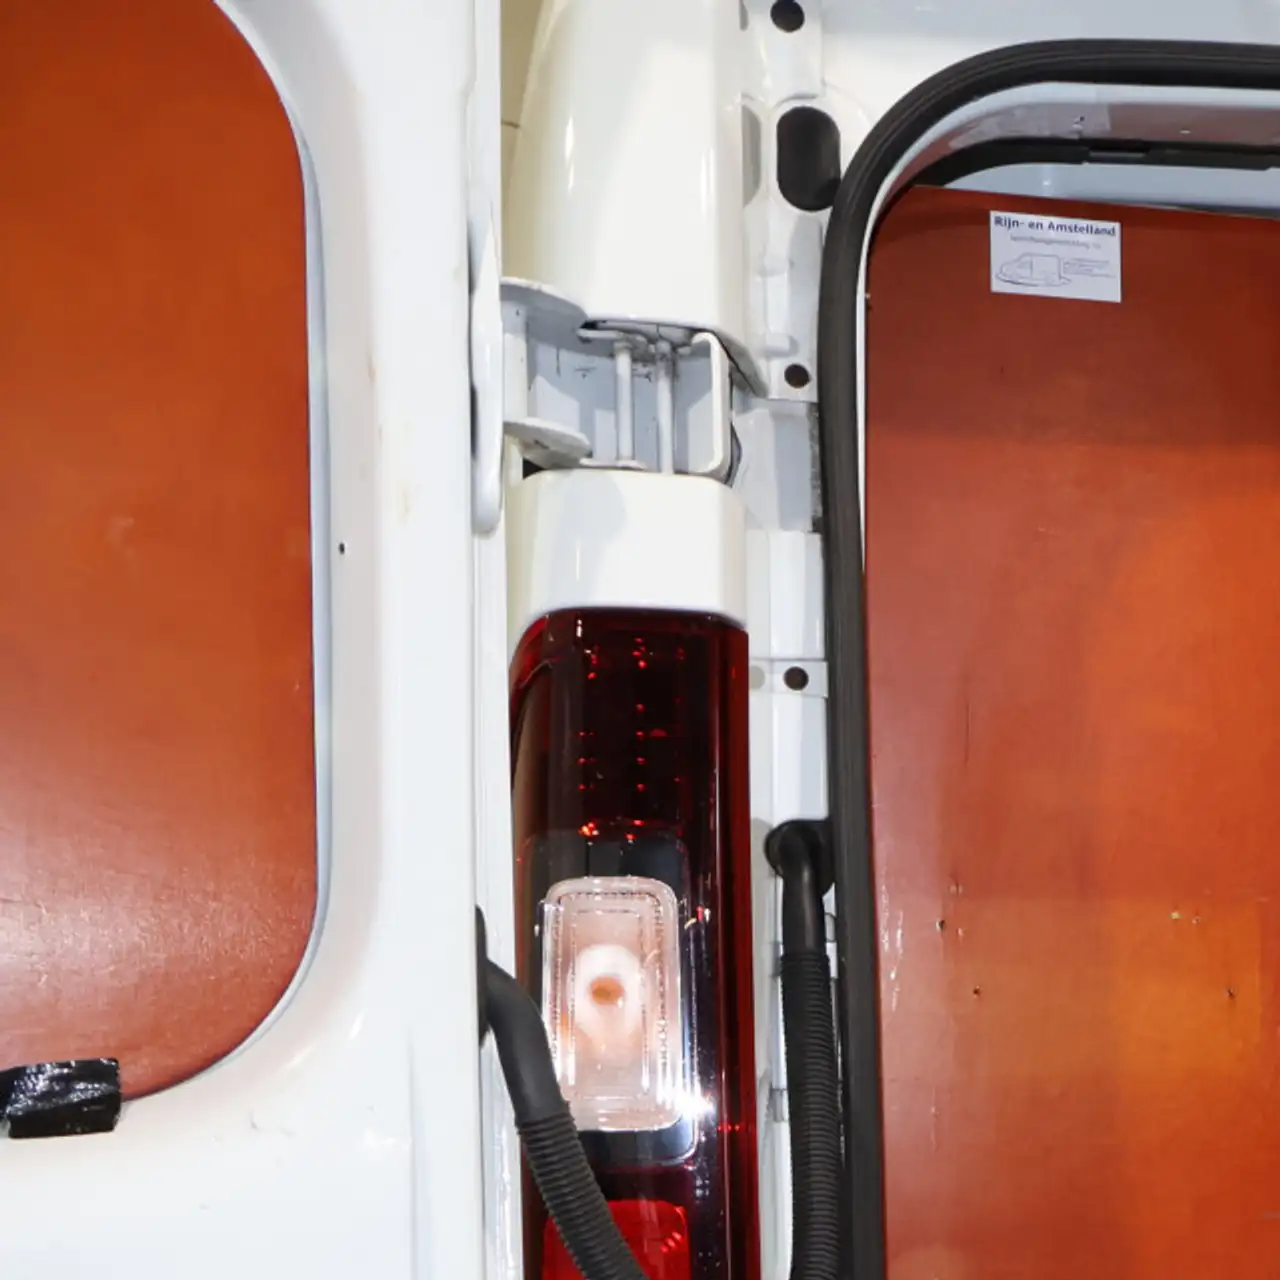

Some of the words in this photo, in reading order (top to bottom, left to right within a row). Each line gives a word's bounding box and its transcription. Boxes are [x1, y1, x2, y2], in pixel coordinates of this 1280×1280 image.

[994, 215, 1024, 231] Rijn-
[1028, 221, 1043, 231] en
[1047, 221, 1116, 237] Amstelland
